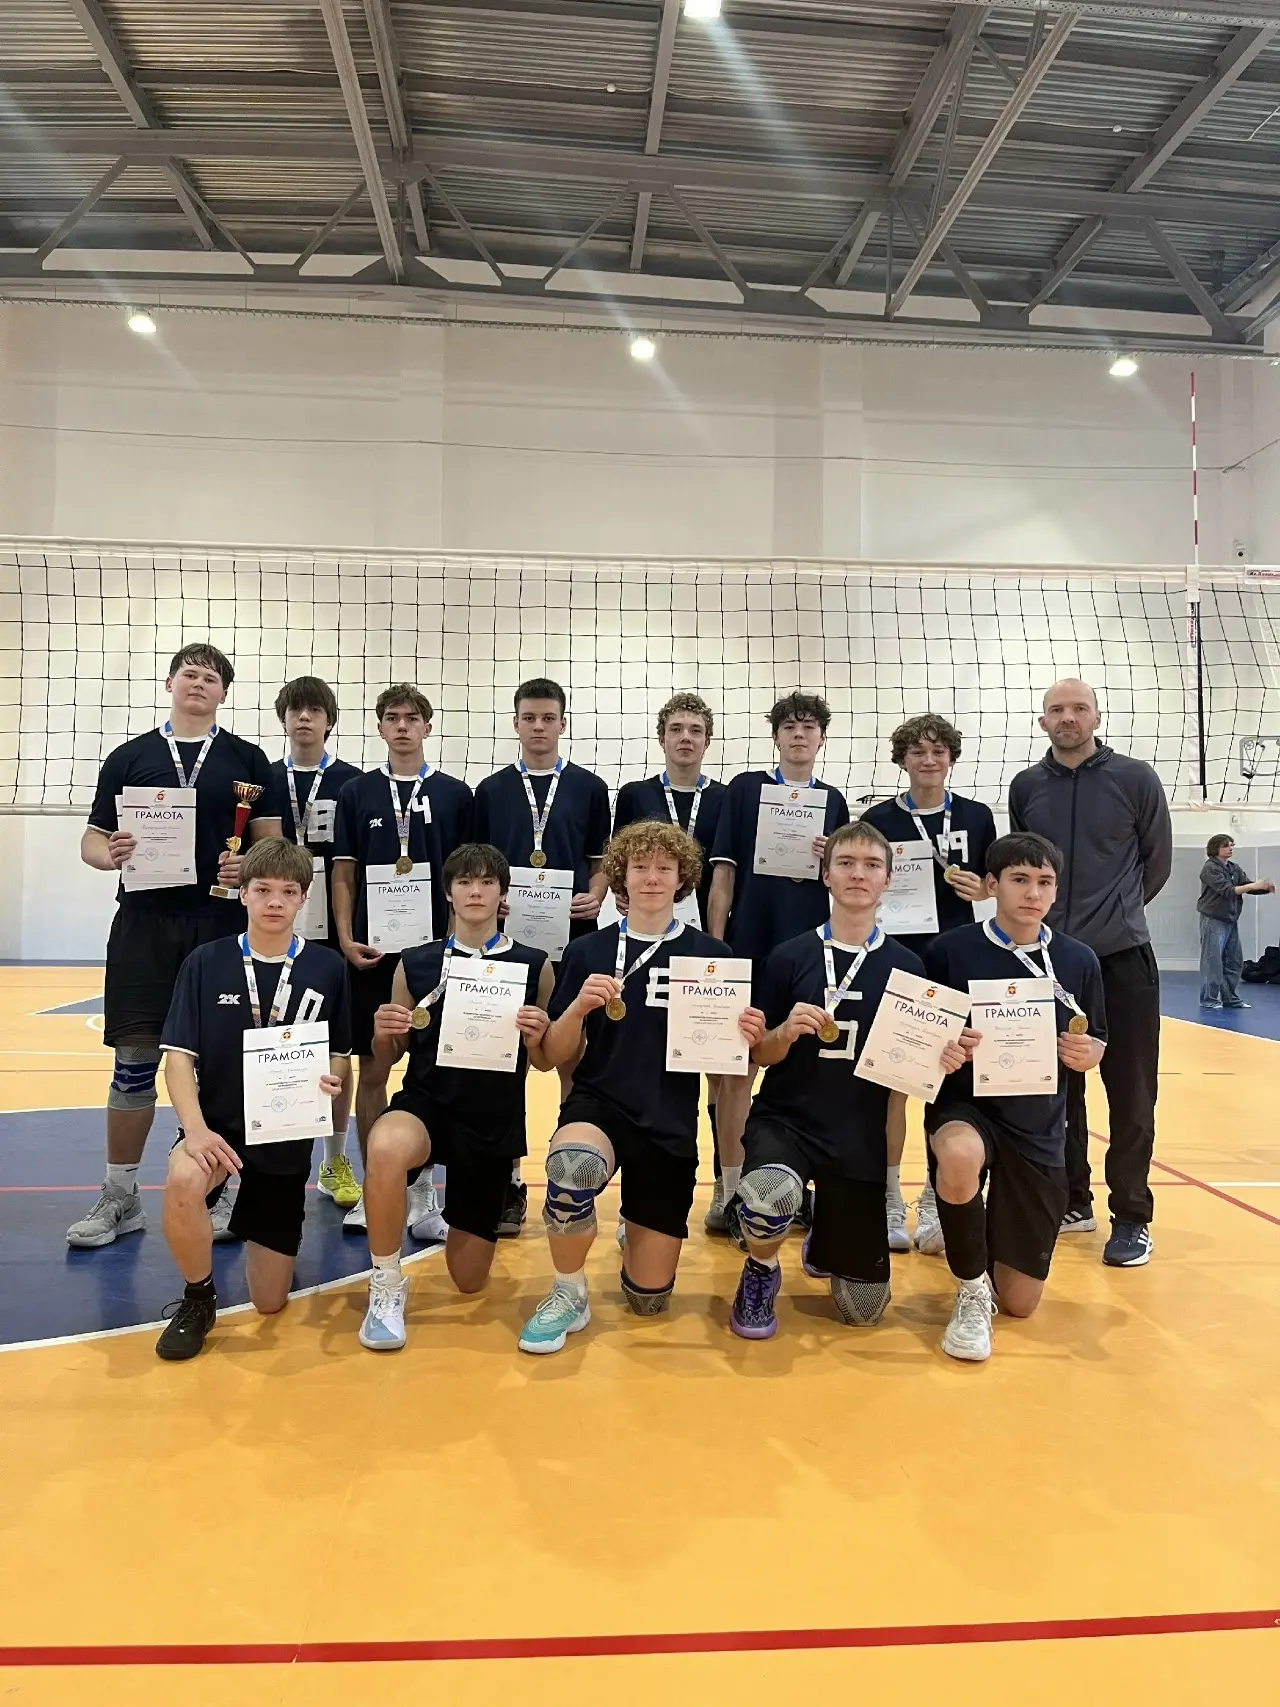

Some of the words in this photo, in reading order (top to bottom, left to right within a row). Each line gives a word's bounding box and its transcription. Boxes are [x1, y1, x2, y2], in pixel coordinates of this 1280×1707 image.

[135, 810, 184, 821] ГРАМОТА
[411, 795, 432, 824] 4
[770, 807, 814, 820] ГРАМОТА
[307, 799, 337, 842] 8
[891, 863, 922, 873] МОТА
[378, 884, 421, 894] ГРАМОТА
[518, 889, 561, 901] ГРАМОТА
[459, 982, 512, 997] ГРАМОТА
[682, 985, 737, 997] ГРАМОТА
[217, 993, 241, 1005] 2K
[276, 984, 325, 1025] 10
[894, 1000, 949, 1028] ГРАМОТА
[985, 1006, 1042, 1019] ГРАМОТА
[258, 1048, 315, 1064] ГРАМОТА
